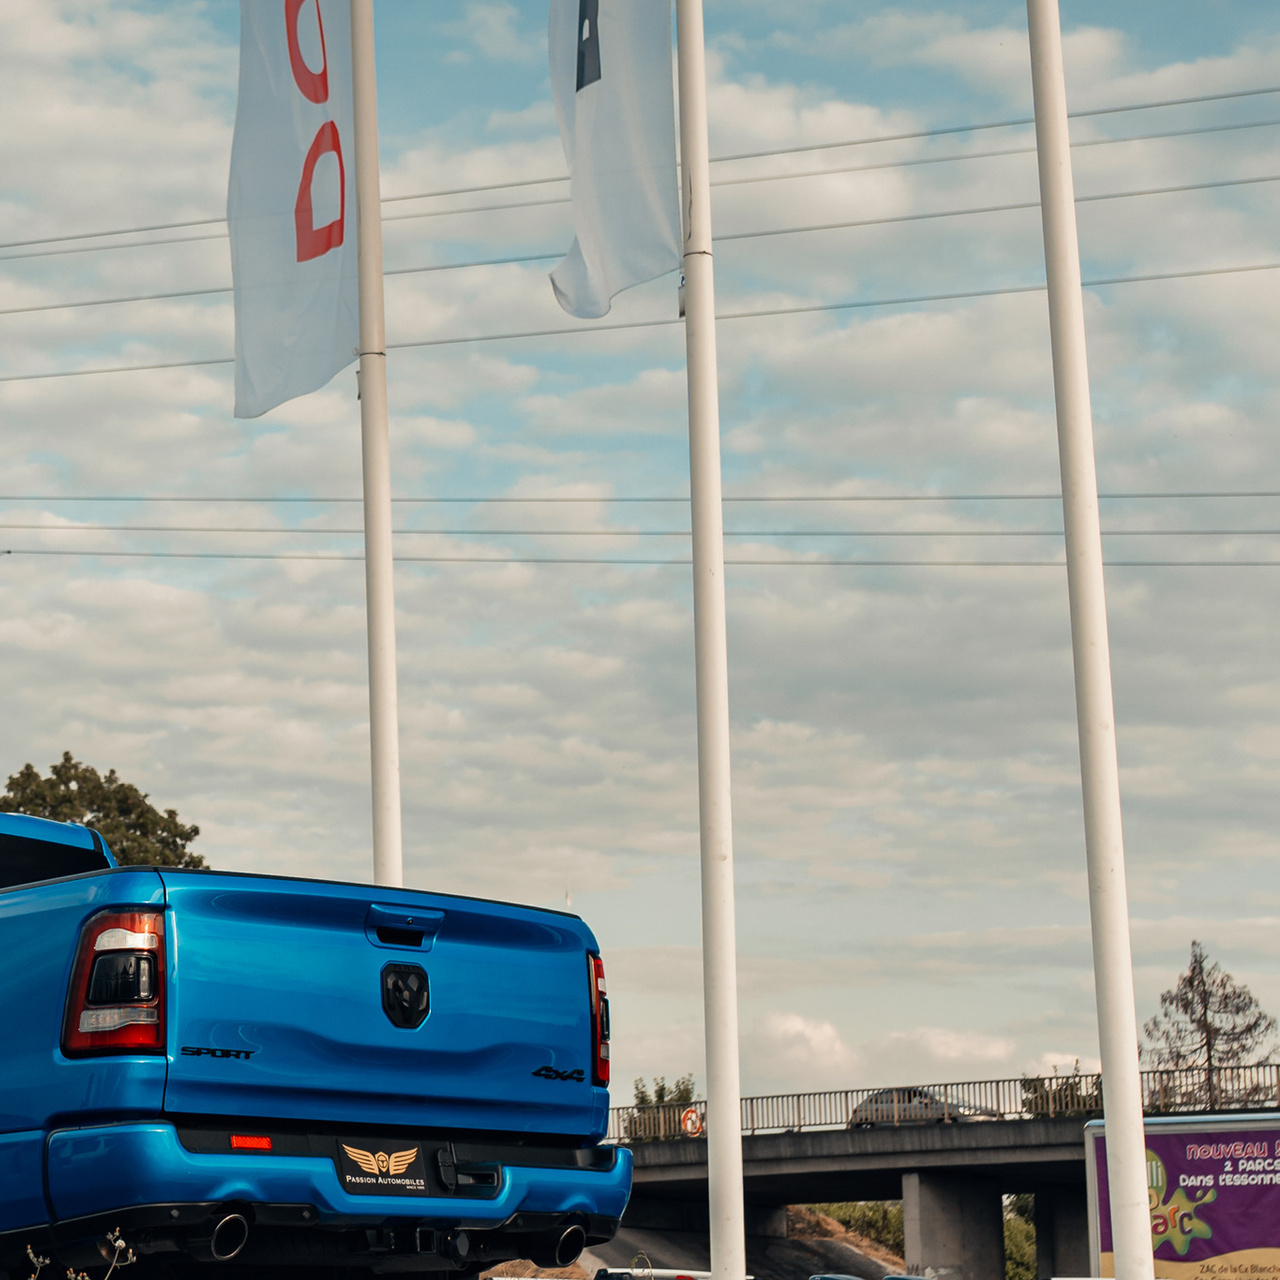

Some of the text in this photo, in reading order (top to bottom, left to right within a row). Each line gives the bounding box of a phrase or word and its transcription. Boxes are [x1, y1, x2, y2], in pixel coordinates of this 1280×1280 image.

[181, 1046, 255, 1060] SPORT
[1224, 1159, 1280, 1172] 2 PARCS
[346, 1175, 425, 1186] PASSION AUTOMOBILES
[1199, 1264, 1216, 1274] ZAC
[1218, 1264, 1229, 1274] de
[1230, 1264, 1237, 1274] la
